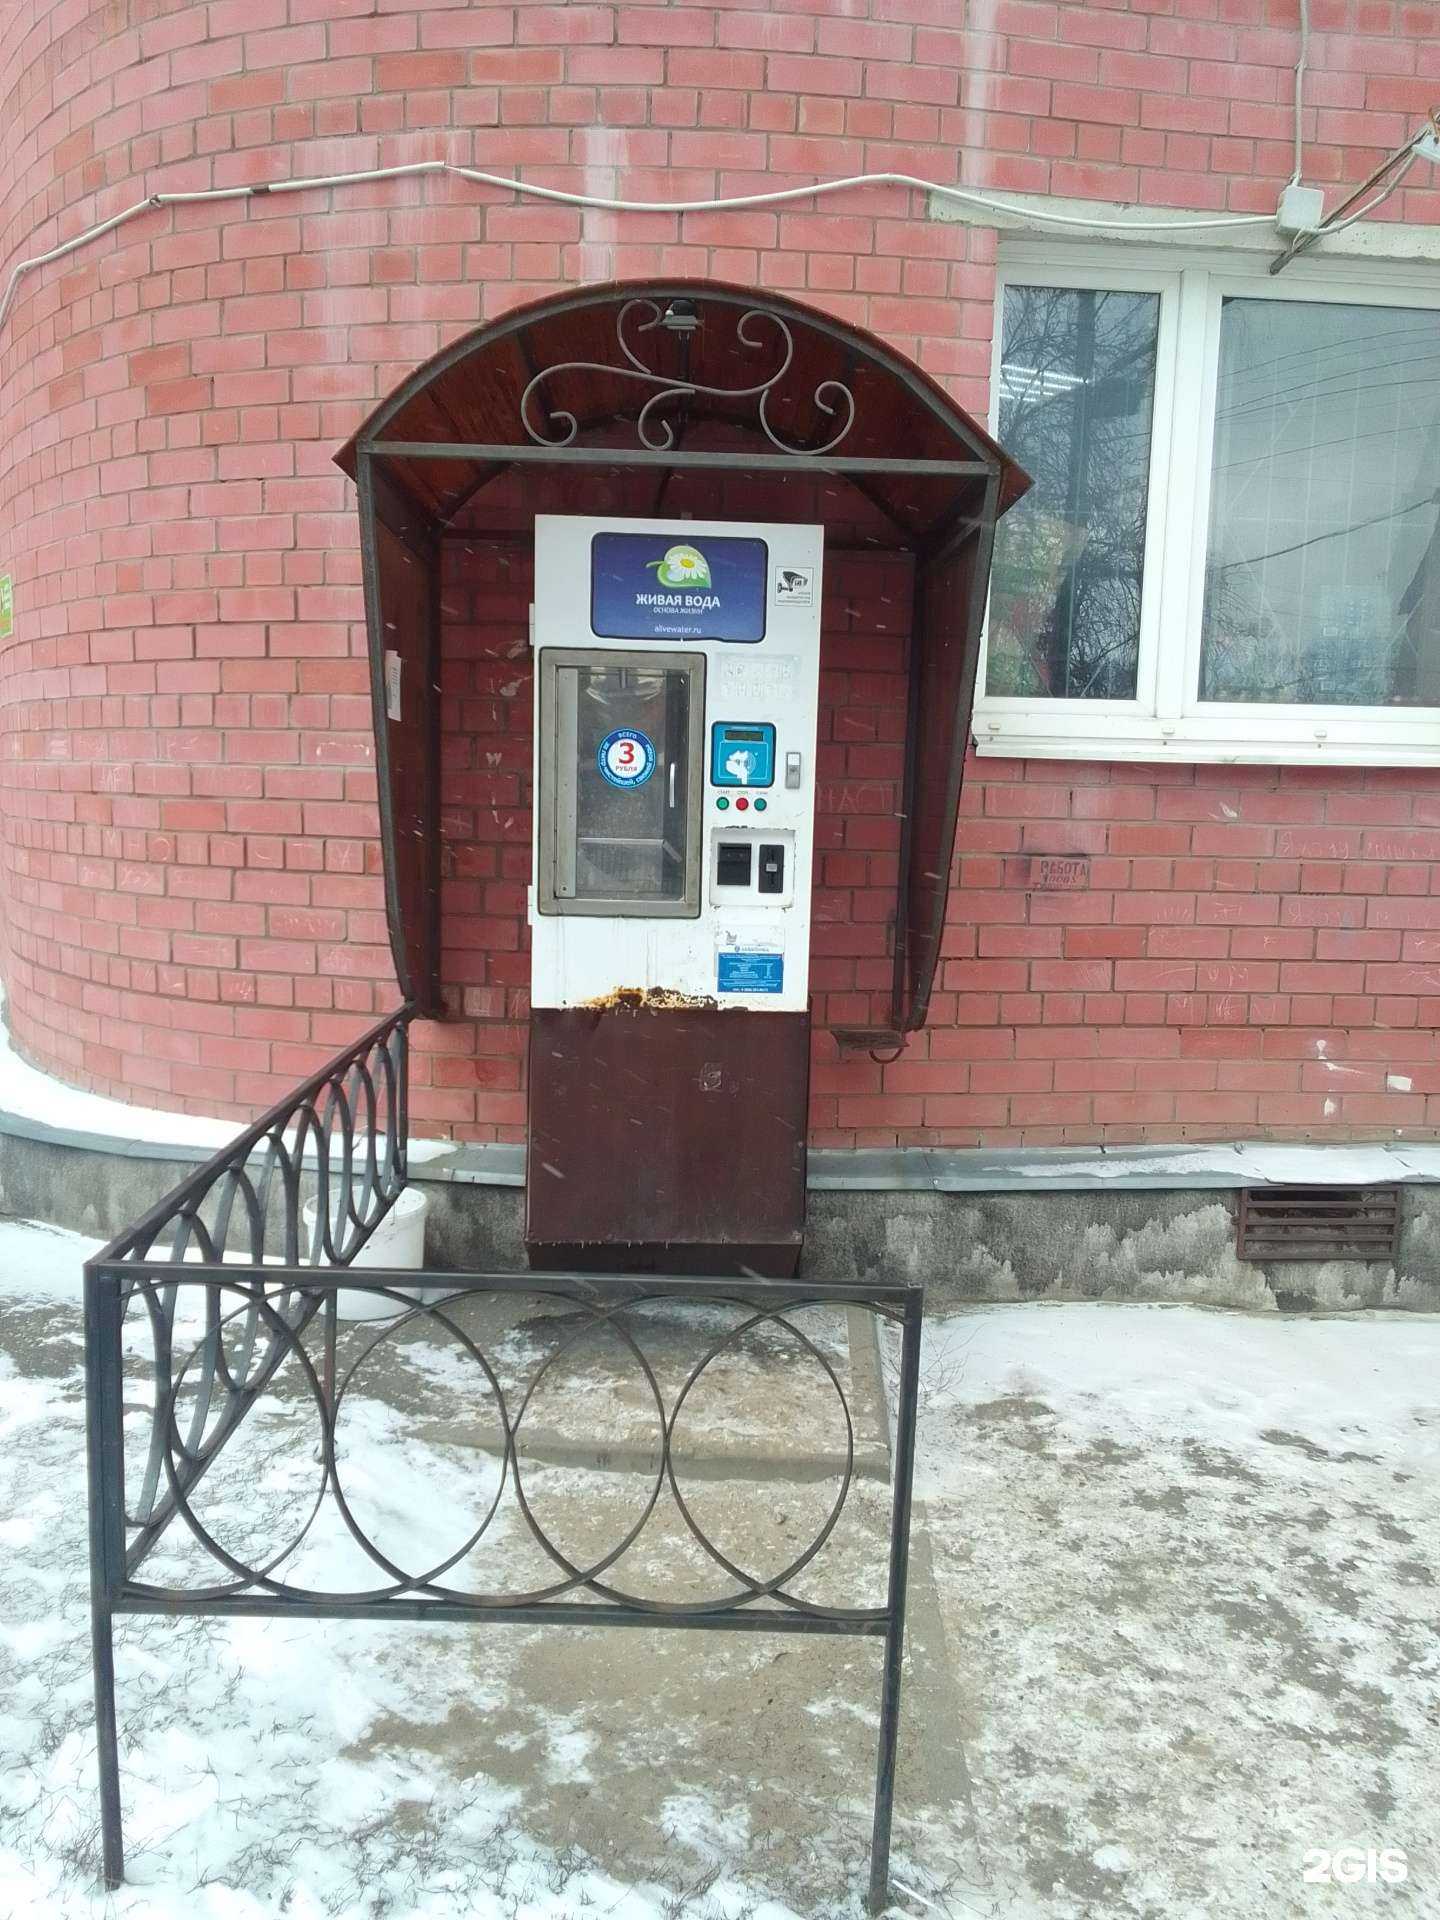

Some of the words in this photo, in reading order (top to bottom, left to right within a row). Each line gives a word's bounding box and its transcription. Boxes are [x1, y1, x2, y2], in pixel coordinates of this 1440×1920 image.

[635, 593, 682, 607] ЖИВАЯ
[684, 595, 721, 610] ВОДА
[654, 623, 702, 634] alivewater.ru
[618, 742, 635, 765] 3
[1040, 860, 1087, 876] РАБОТА
